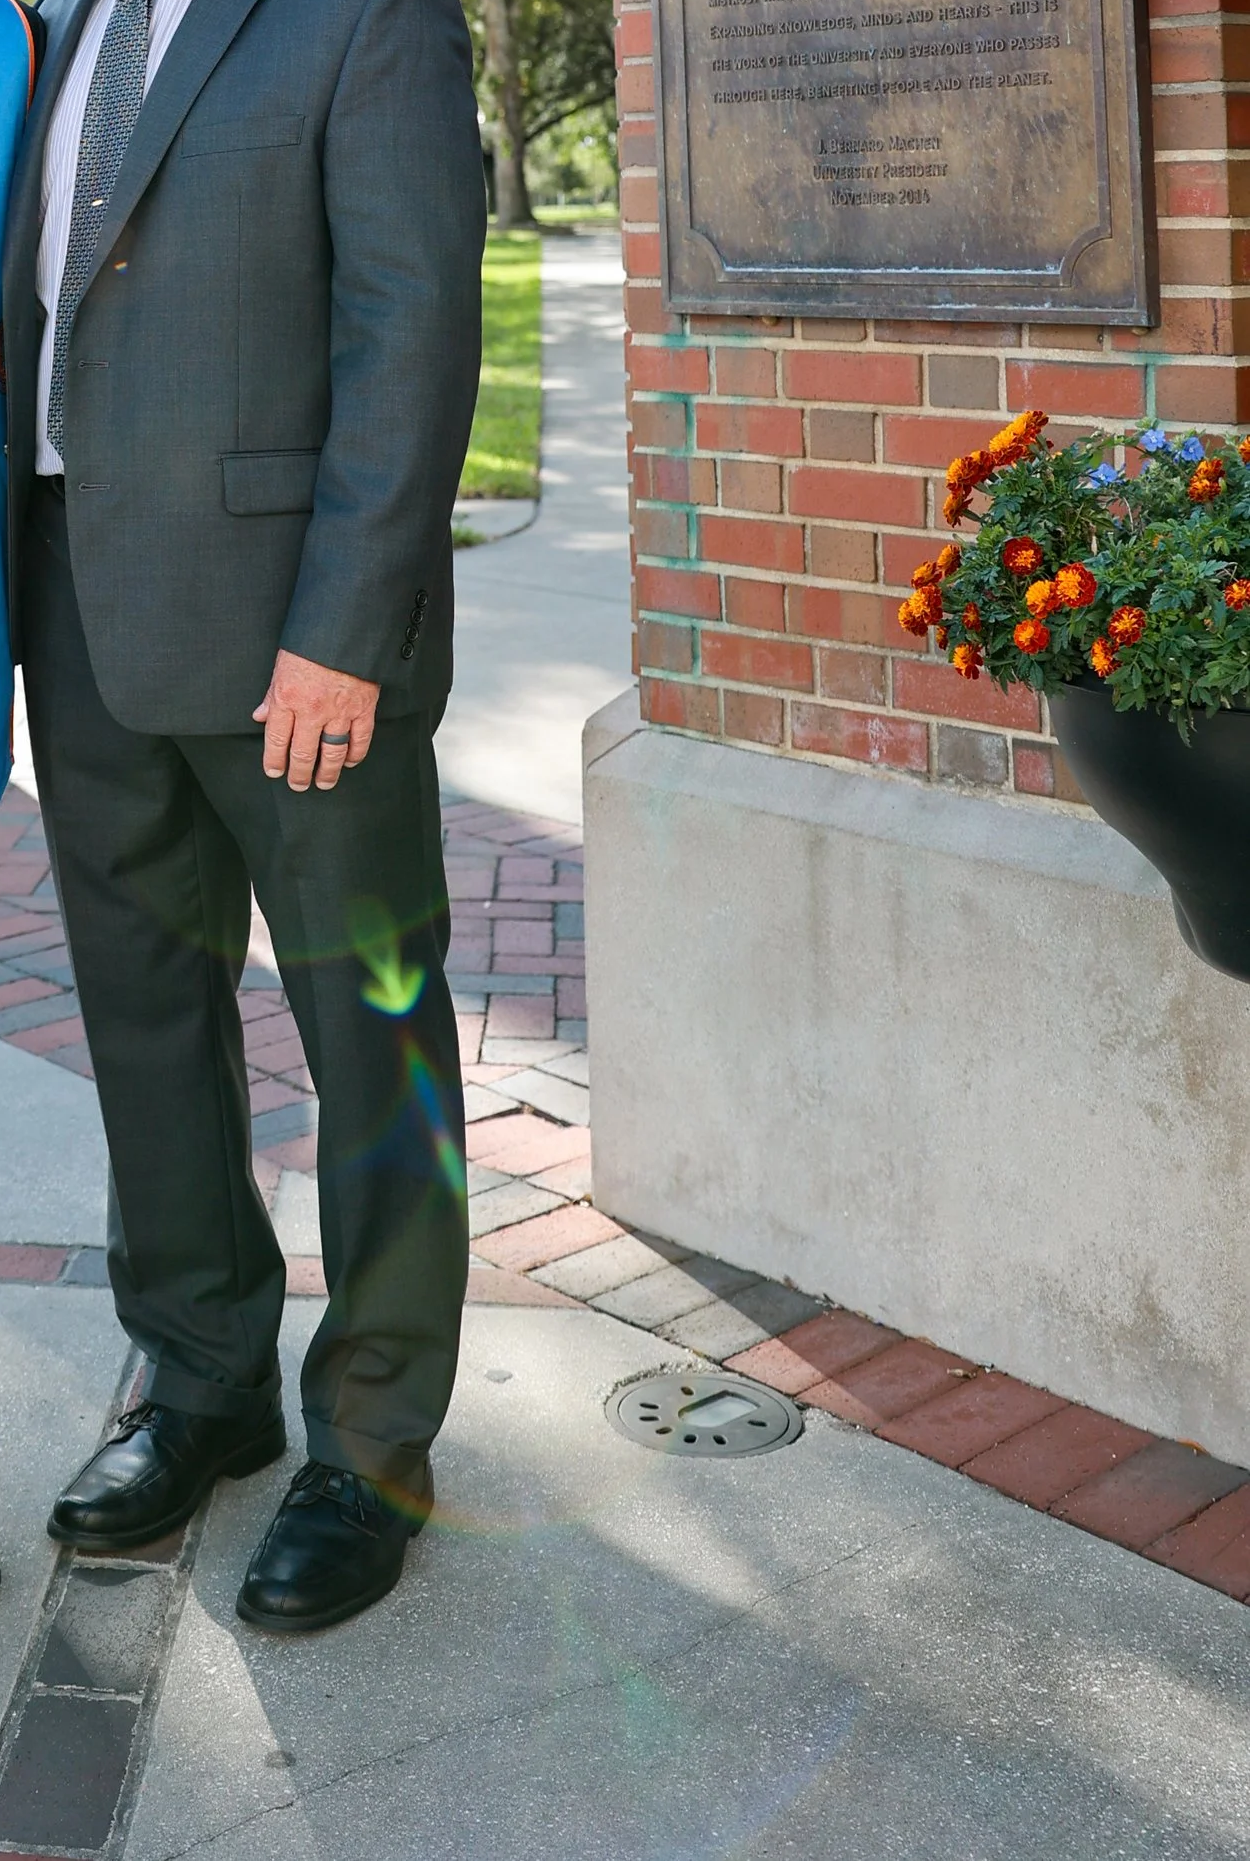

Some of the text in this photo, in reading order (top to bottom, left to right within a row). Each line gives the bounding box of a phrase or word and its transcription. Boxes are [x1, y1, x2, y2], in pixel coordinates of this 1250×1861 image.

[710, 24, 774, 40] EXPANDING
[777, 16, 856, 34] KNOWLEDGE,
[861, 12, 902, 27] MINDS
[907, 9, 933, 23] AND
[939, 4, 991, 20] HEARTS
[1008, 0, 1039, 15] THIS
[712, 34, 1060, 72] THE WORK OF THE UNIVERSITY AND EVERYONE WHO PASSES
[712, 71, 1052, 104] THROUGH HERE, BENEFITING PEOPLE AND THE PLANET.
[830, 138, 884, 154] BERNARD
[889, 135, 940, 151] MACHEN
[813, 162, 948, 180] UNIVERSITY PRESIDENT
[829, 188, 896, 206] NOVEMBER
